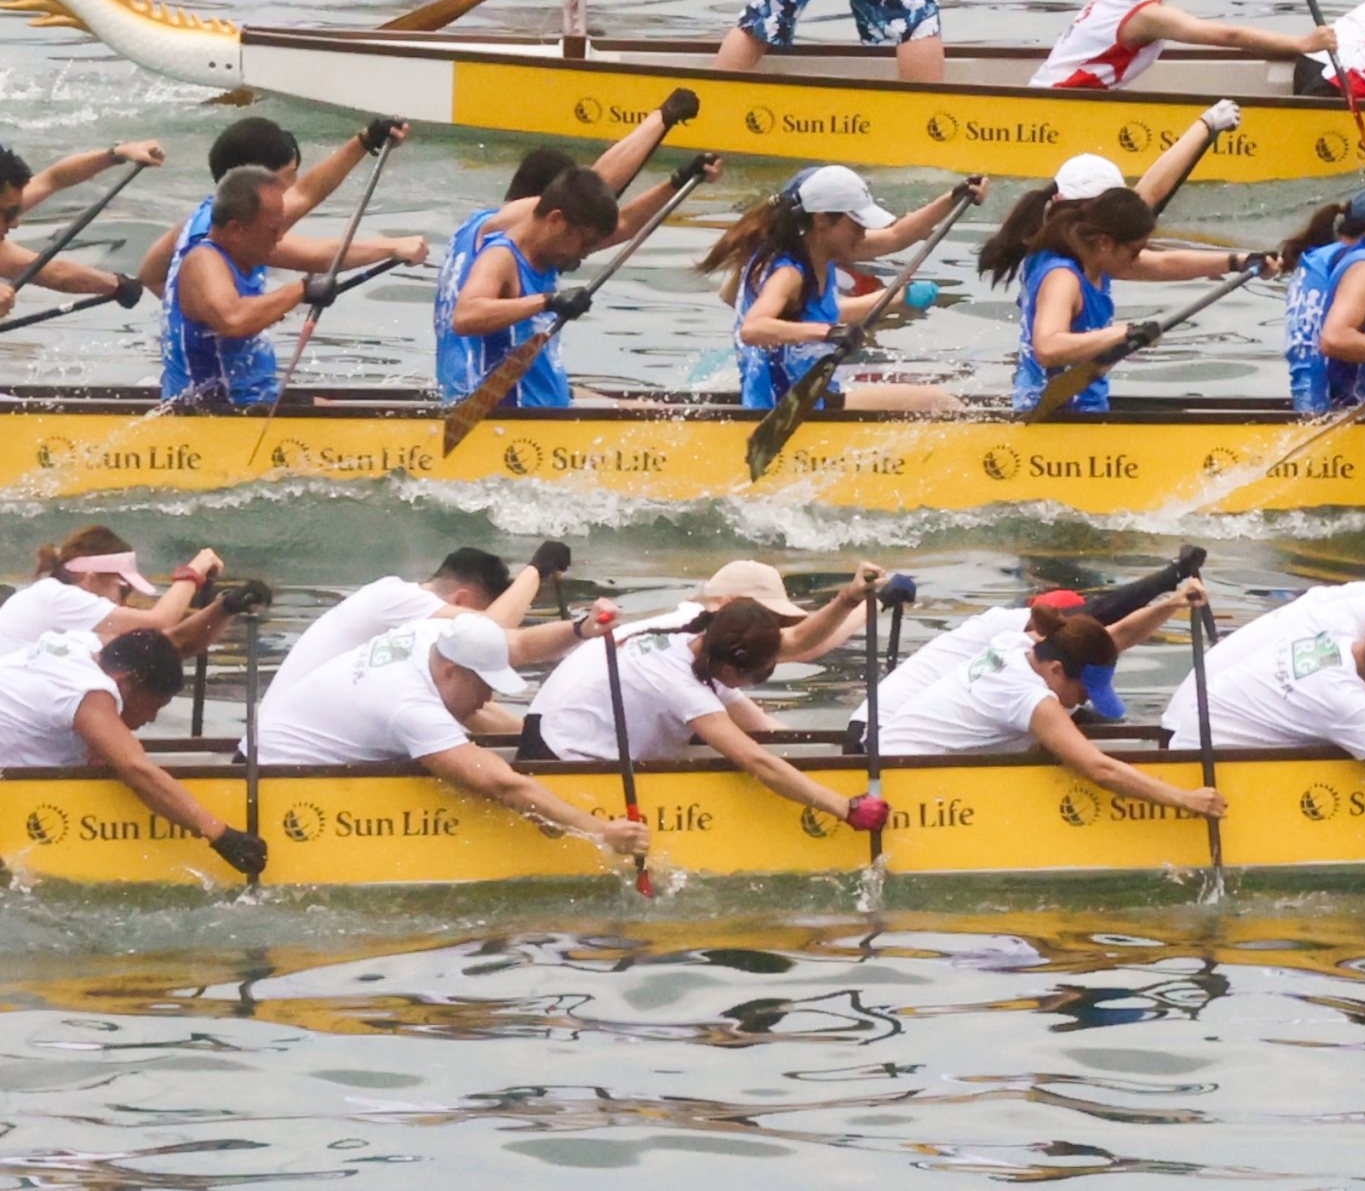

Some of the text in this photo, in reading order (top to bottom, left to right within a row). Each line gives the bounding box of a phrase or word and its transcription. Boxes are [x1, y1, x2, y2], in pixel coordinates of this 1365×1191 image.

[783, 117, 870, 134] Sun Life
[965, 123, 1059, 143] Sun Life
[1212, 135, 1256, 156] Life
[151, 445, 201, 469] Life
[320, 447, 434, 472] Sun Life
[1030, 456, 1138, 478] Sun Life
[1307, 456, 1354, 479] Life
[336, 810, 459, 836] Sun Life
[658, 808, 713, 831] Life
[918, 800, 974, 828] Life
[79, 816, 140, 839] Sun
